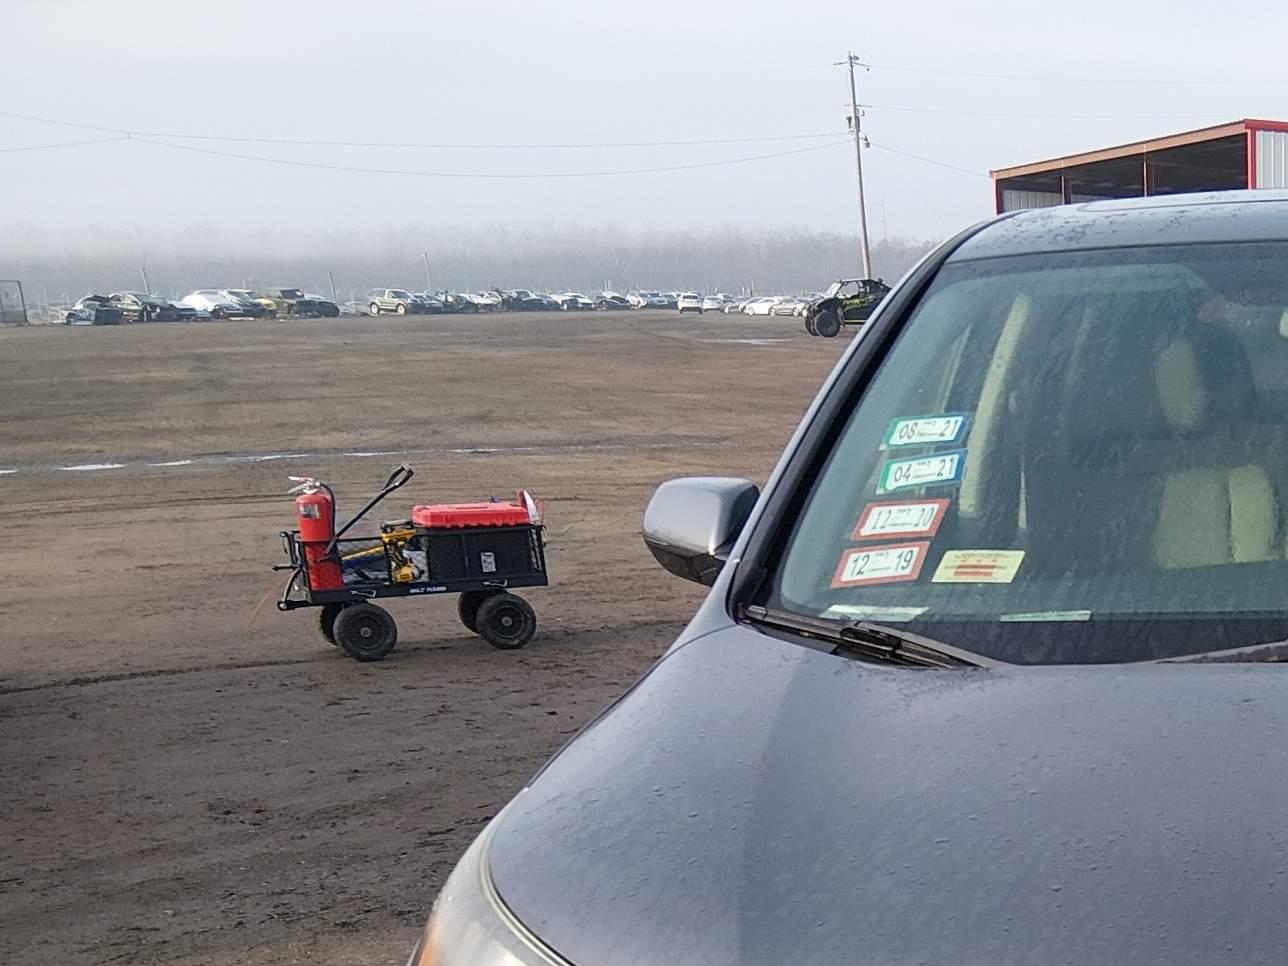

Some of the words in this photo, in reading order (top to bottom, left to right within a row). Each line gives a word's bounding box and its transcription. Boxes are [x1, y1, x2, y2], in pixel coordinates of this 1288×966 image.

[938, 419, 960, 438] 21
[894, 463, 913, 483] 04
[936, 457, 955, 477] 21
[850, 554, 871, 576] 12
[894, 549, 914, 571] 19
